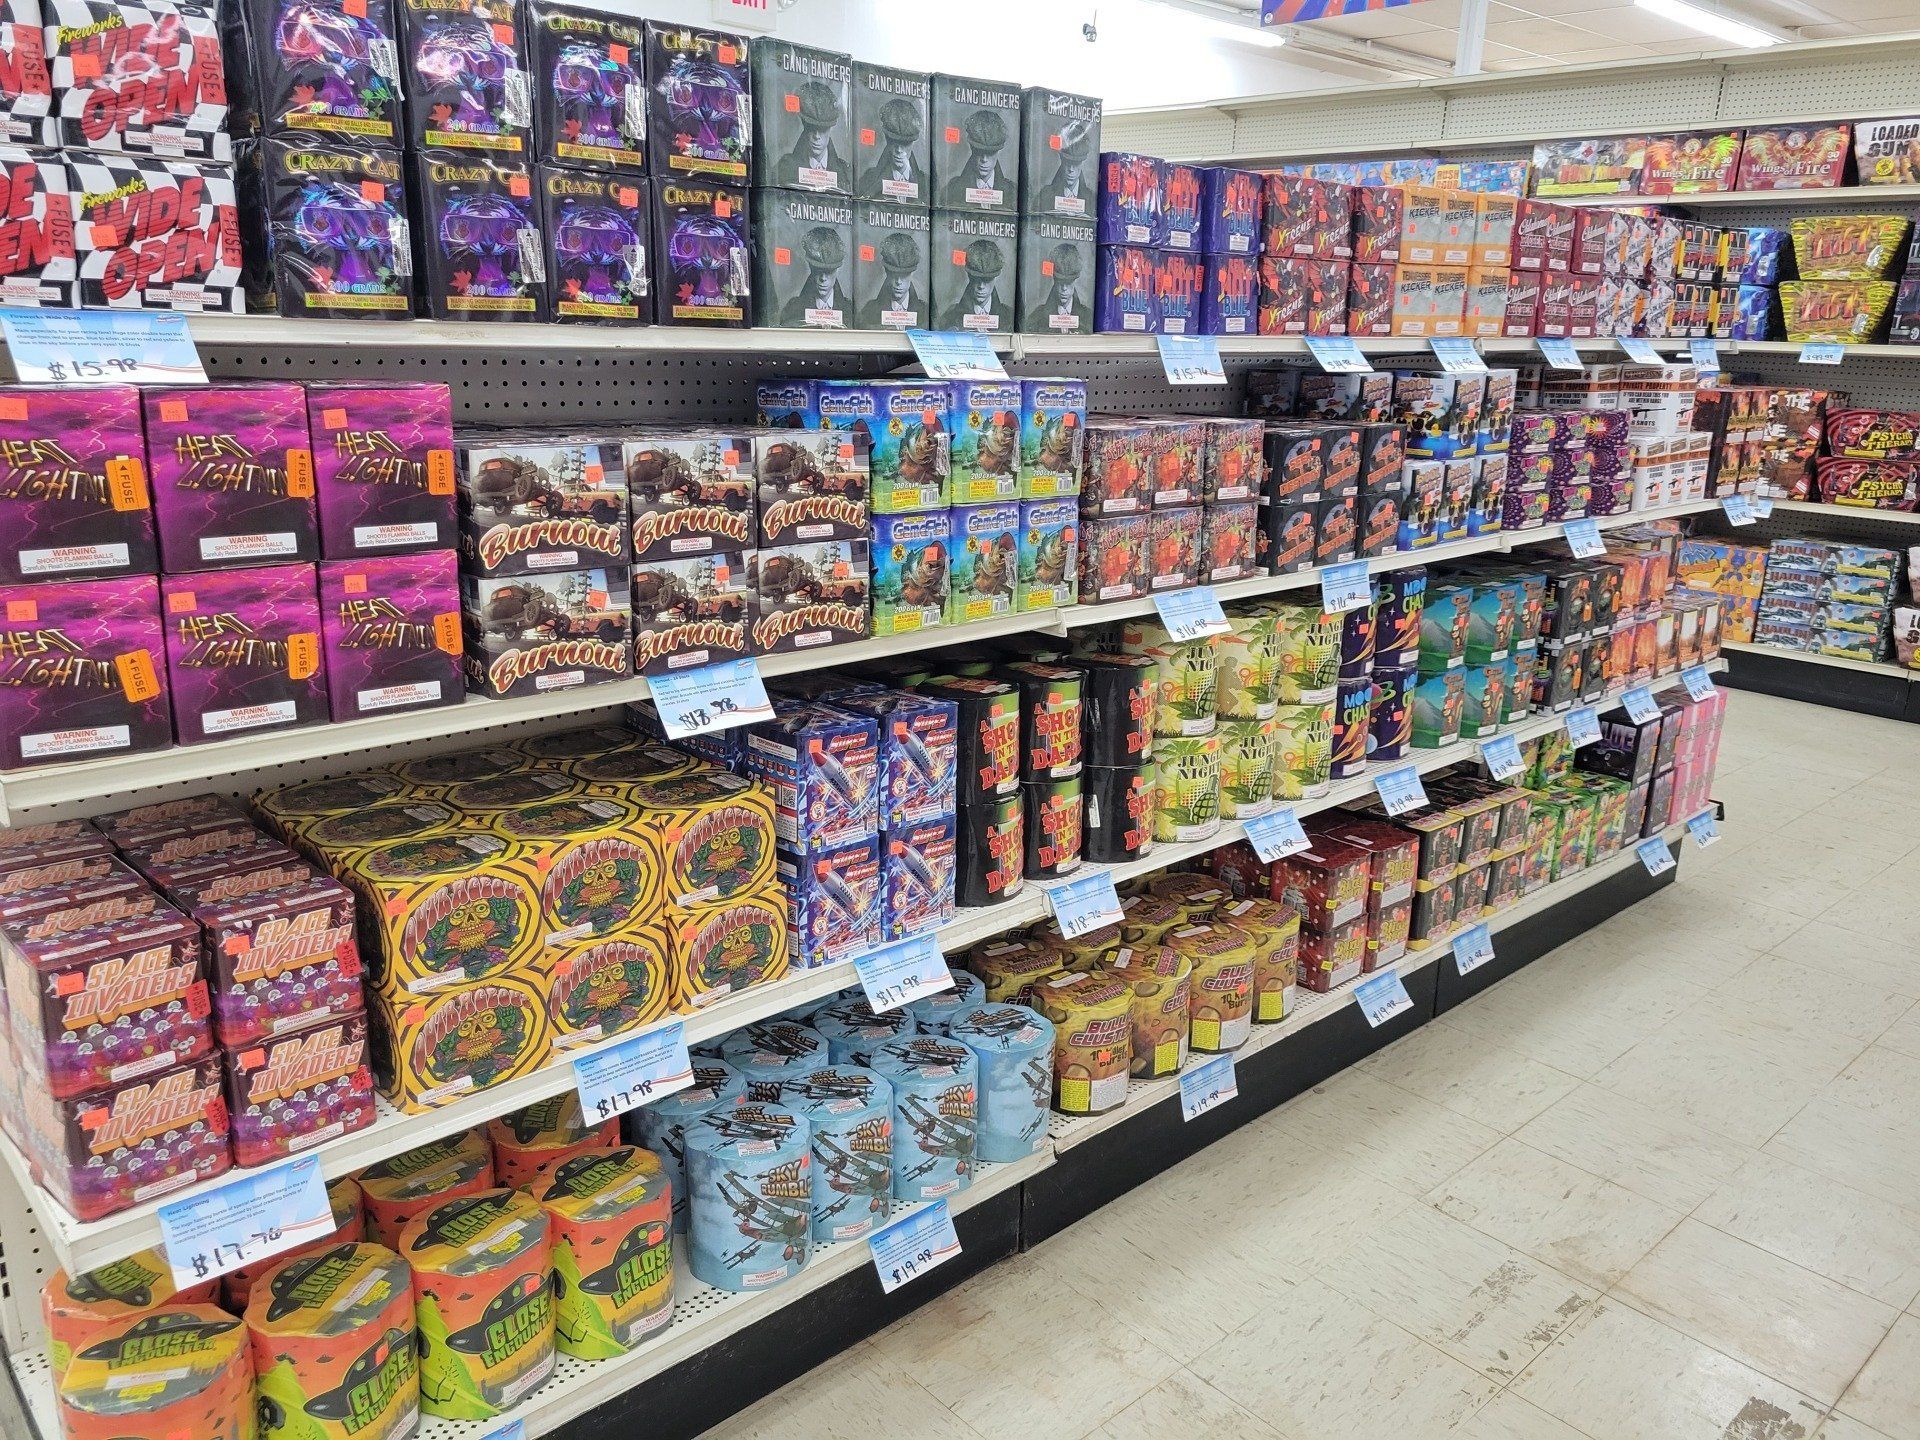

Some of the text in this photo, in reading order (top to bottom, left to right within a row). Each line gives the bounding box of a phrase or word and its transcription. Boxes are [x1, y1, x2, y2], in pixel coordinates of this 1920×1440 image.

[57, 13, 122, 45] Fireworks
[549, 12, 640, 44] CRAZY CAT
[22, 38, 43, 87] FUSE
[199, 44, 222, 93] FUSE
[783, 54, 851, 83] GANG BANGERS
[868, 74, 930, 100] GANG BANGERS
[955, 87, 1020, 110] GANG BANGERS
[80, 64, 202, 141] OPEN
[335, 104, 369, 117] GRAMS
[447, 119, 467, 131] 200
[1871, 124, 1920, 142] LOADED
[1721, 156, 1732, 164] 30
[1866, 140, 1910, 158] GUN
[285, 151, 400, 178] CRAZY CAT
[431, 163, 492, 183] CRAZY
[1652, 168, 1684, 180] Wings
[1692, 166, 1725, 180] Fire
[1751, 162, 1831, 175] Wings of Fire
[80, 178, 145, 211] Fireworks
[548, 175, 604, 195] CRAZY
[664, 187, 712, 205] CRAZY
[93, 178, 204, 250] WIDE
[869, 211, 930, 231] GANG BANGERS
[1409, 207, 1440, 218] KICKER
[1445, 210, 1474, 221] KICKER
[1485, 211, 1513, 222] KICKER
[50, 207, 73, 252] FUSE
[224, 215, 241, 260] FUSE
[953, 219, 1016, 238] GANG BANGERS
[1275, 218, 1312, 252] XTREME
[1811, 228, 1868, 259] HOT
[102, 221, 220, 300] OPEN
[328, 281, 386, 294] 200 GRAMS
[1122, 288, 1149, 312] BLUE
[1400, 281, 1431, 293] KICKER
[1435, 282, 1465, 294] KICKER
[1478, 285, 1507, 297] KICKER
[1163, 295, 1188, 317] BLUE
[1223, 294, 1249, 317] BLUE
[1800, 292, 1858, 322] HOT
[48, 358, 138, 381] $15.98
[1786, 393, 1811, 412] THE
[174, 433, 254, 464] HEAT
[334, 430, 403, 459] HEAT
[1867, 439, 1914, 450] THERAPY
[1869, 431, 1913, 443] PSYCHO
[120, 474, 135, 504] FUSE
[1859, 481, 1904, 491] PSYCHO
[379, 525, 413, 533] WARNING
[633, 507, 749, 555] Burnout
[762, 496, 867, 541] Burnout
[52, 547, 97, 557] WARNING
[229, 535, 268, 544] WARNING
[478, 519, 623, 571] Burnout
[36, 556, 63, 564] SHOOTS
[64, 554, 93, 562] FLAMING
[1788, 554, 1814, 565] ASS
[1783, 581, 1809, 592] ASS
[338, 596, 406, 630] HEAT
[178, 611, 255, 645] HEAT
[442, 625, 455, 651] FUSE
[757, 604, 866, 649] Burnout
[634, 622, 747, 671] Burnout
[298, 646, 308, 675] FUSE
[489, 642, 628, 694] Burnout
[130, 666, 147, 696] FUSE
[382, 685, 416, 695] WARNING
[230, 706, 268, 716] WARNING
[1034, 703, 1044, 715] A
[53, 729, 98, 740] WARNING
[756, 737, 782, 750] PERFORMANCE
[1050, 732, 1062, 744] IN
[945, 747, 955, 755] 25
[866, 765, 877, 775] 25
[944, 857, 954, 865] 25
[868, 879, 879, 889] 25
[255, 907, 332, 948] SPACE
[234, 923, 353, 978] INVADERS
[85, 946, 172, 990] SPACE
[64, 961, 198, 1022] INVADERS
[876, 974, 921, 1007] $17.98
[1373, 999, 1397, 1023] $19.98
[269, 1026, 343, 1068] SPACE
[249, 1041, 365, 1098] INVADERS
[113, 1069, 197, 1117] SPACE
[596, 1079, 653, 1119] $17.98
[943, 1085, 973, 1105] SKY
[1190, 1090, 1219, 1116] $19.98
[90, 1082, 220, 1150] INVADERS
[856, 1118, 888, 1140] SKY
[566, 1160, 618, 1192] CLOSE
[573, 1161, 643, 1200] ENCOUNTER
[768, 1158, 802, 1181] SKY
[440, 1201, 500, 1239] CLOSE
[191, 1227, 283, 1279] $17.76
[291, 1256, 352, 1300] CLOSE
[617, 1243, 673, 1290] CLOSE
[892, 1249, 932, 1284] $19.98
[487, 1289, 550, 1348] CLOSE
[122, 1331, 202, 1360] CLOSE
